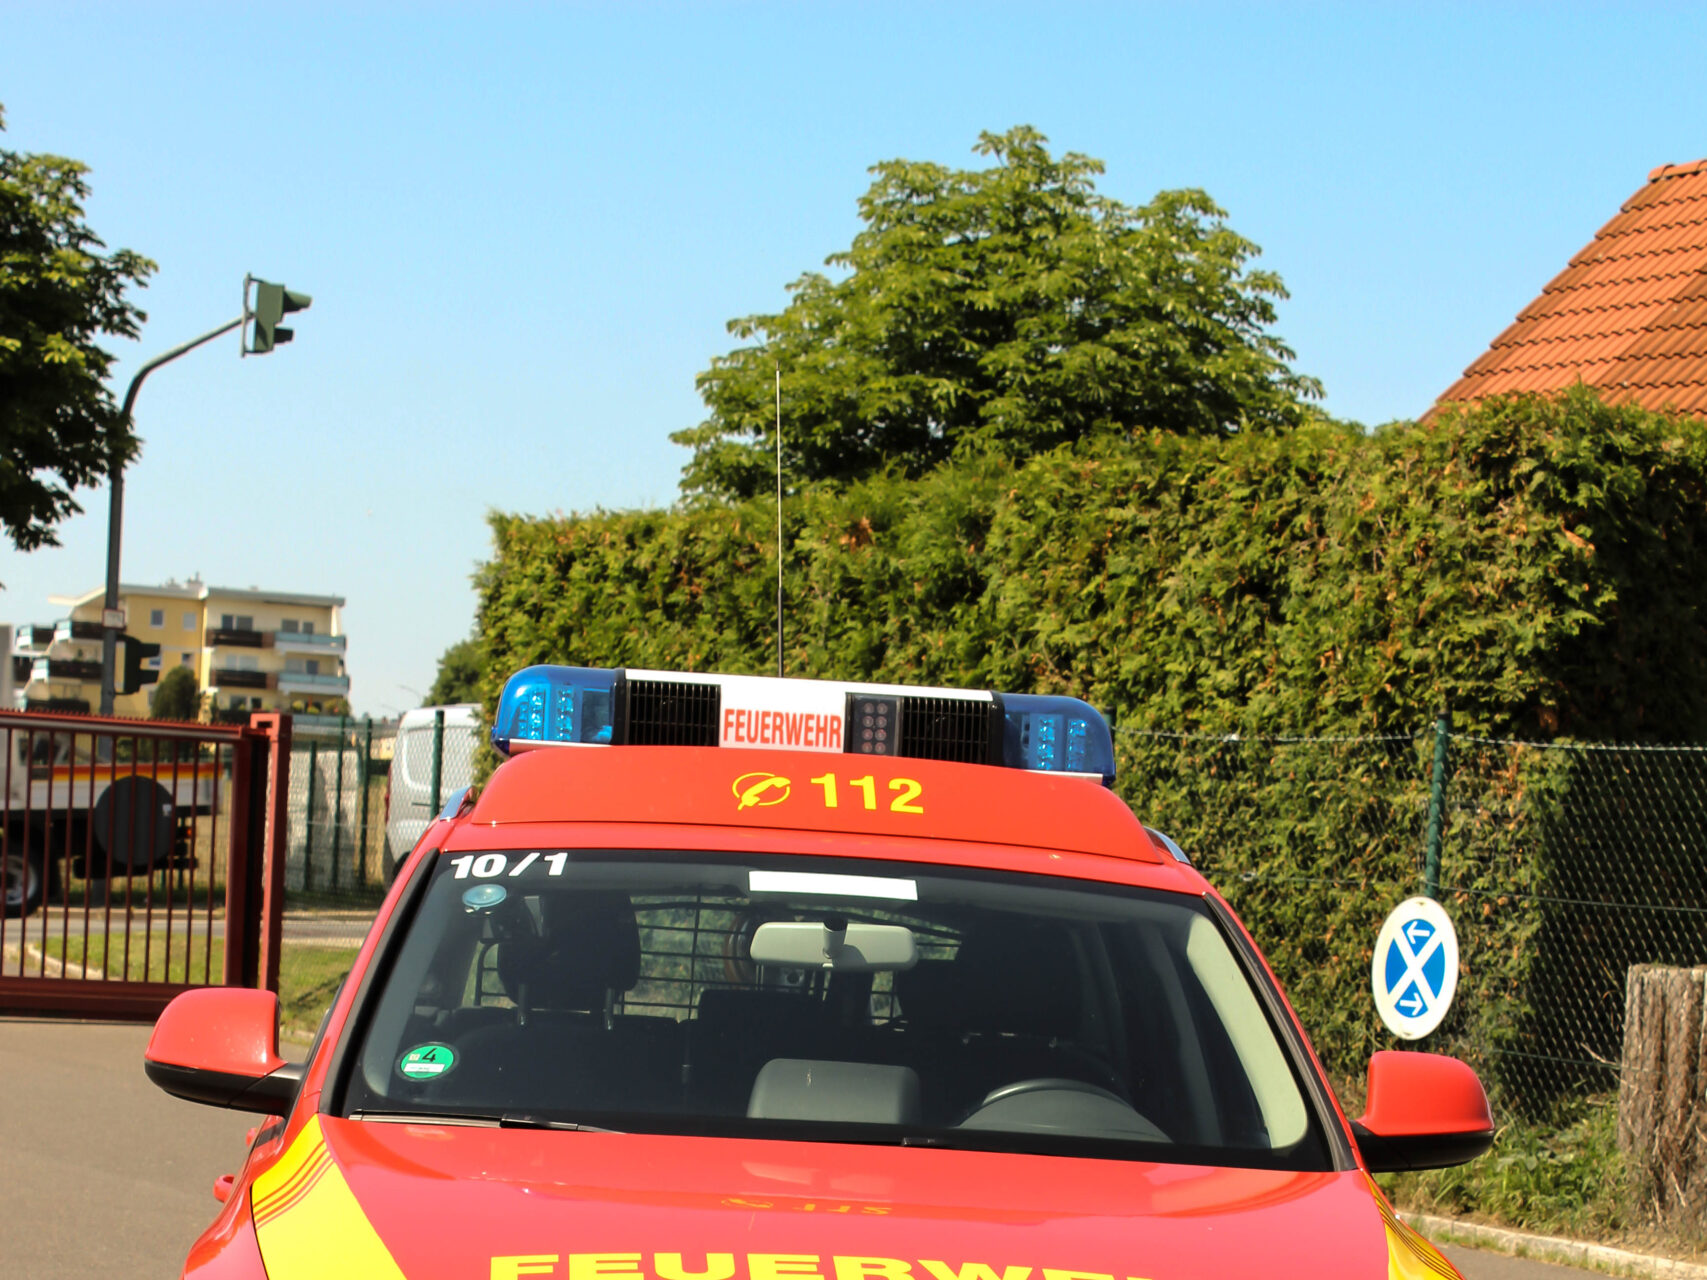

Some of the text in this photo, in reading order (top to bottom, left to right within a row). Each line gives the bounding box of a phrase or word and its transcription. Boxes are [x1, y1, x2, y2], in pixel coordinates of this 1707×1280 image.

[723, 708, 842, 749] FEUERWEHR
[810, 773, 924, 814] 112
[450, 852, 568, 879] 10/1
[421, 1047, 437, 1062] 4
